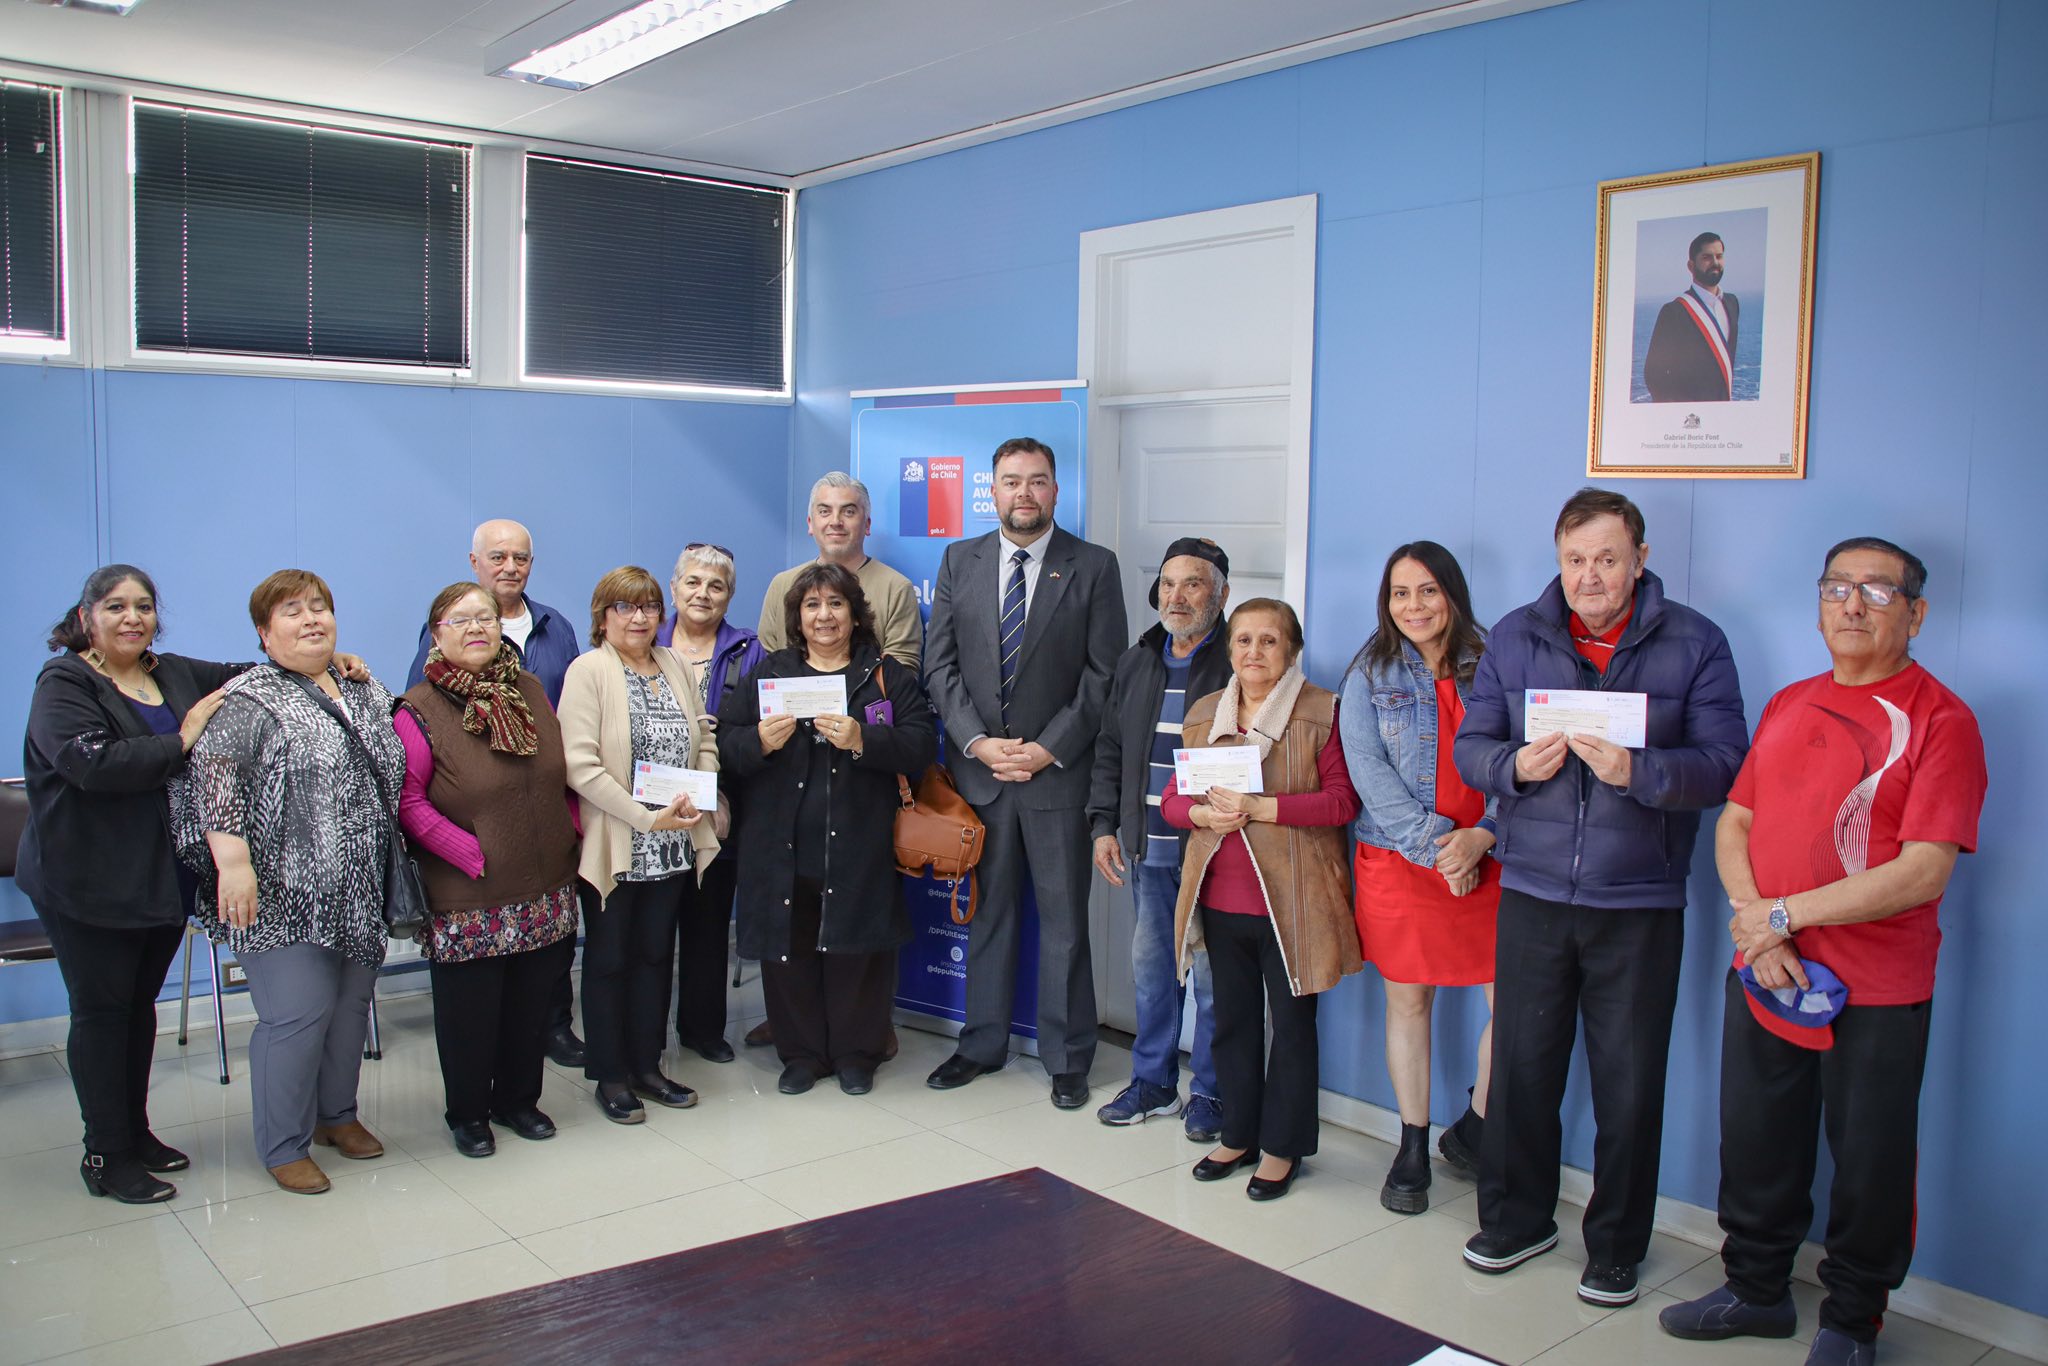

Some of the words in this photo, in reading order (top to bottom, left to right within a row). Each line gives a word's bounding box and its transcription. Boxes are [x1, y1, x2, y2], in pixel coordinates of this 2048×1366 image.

[1663, 433, 1687, 441] Gabriel
[1687, 433, 1704, 441] Boric
[1705, 433, 1720, 441] Font
[930, 463, 961, 471] Gobierno
[940, 471, 957, 479] Chile
